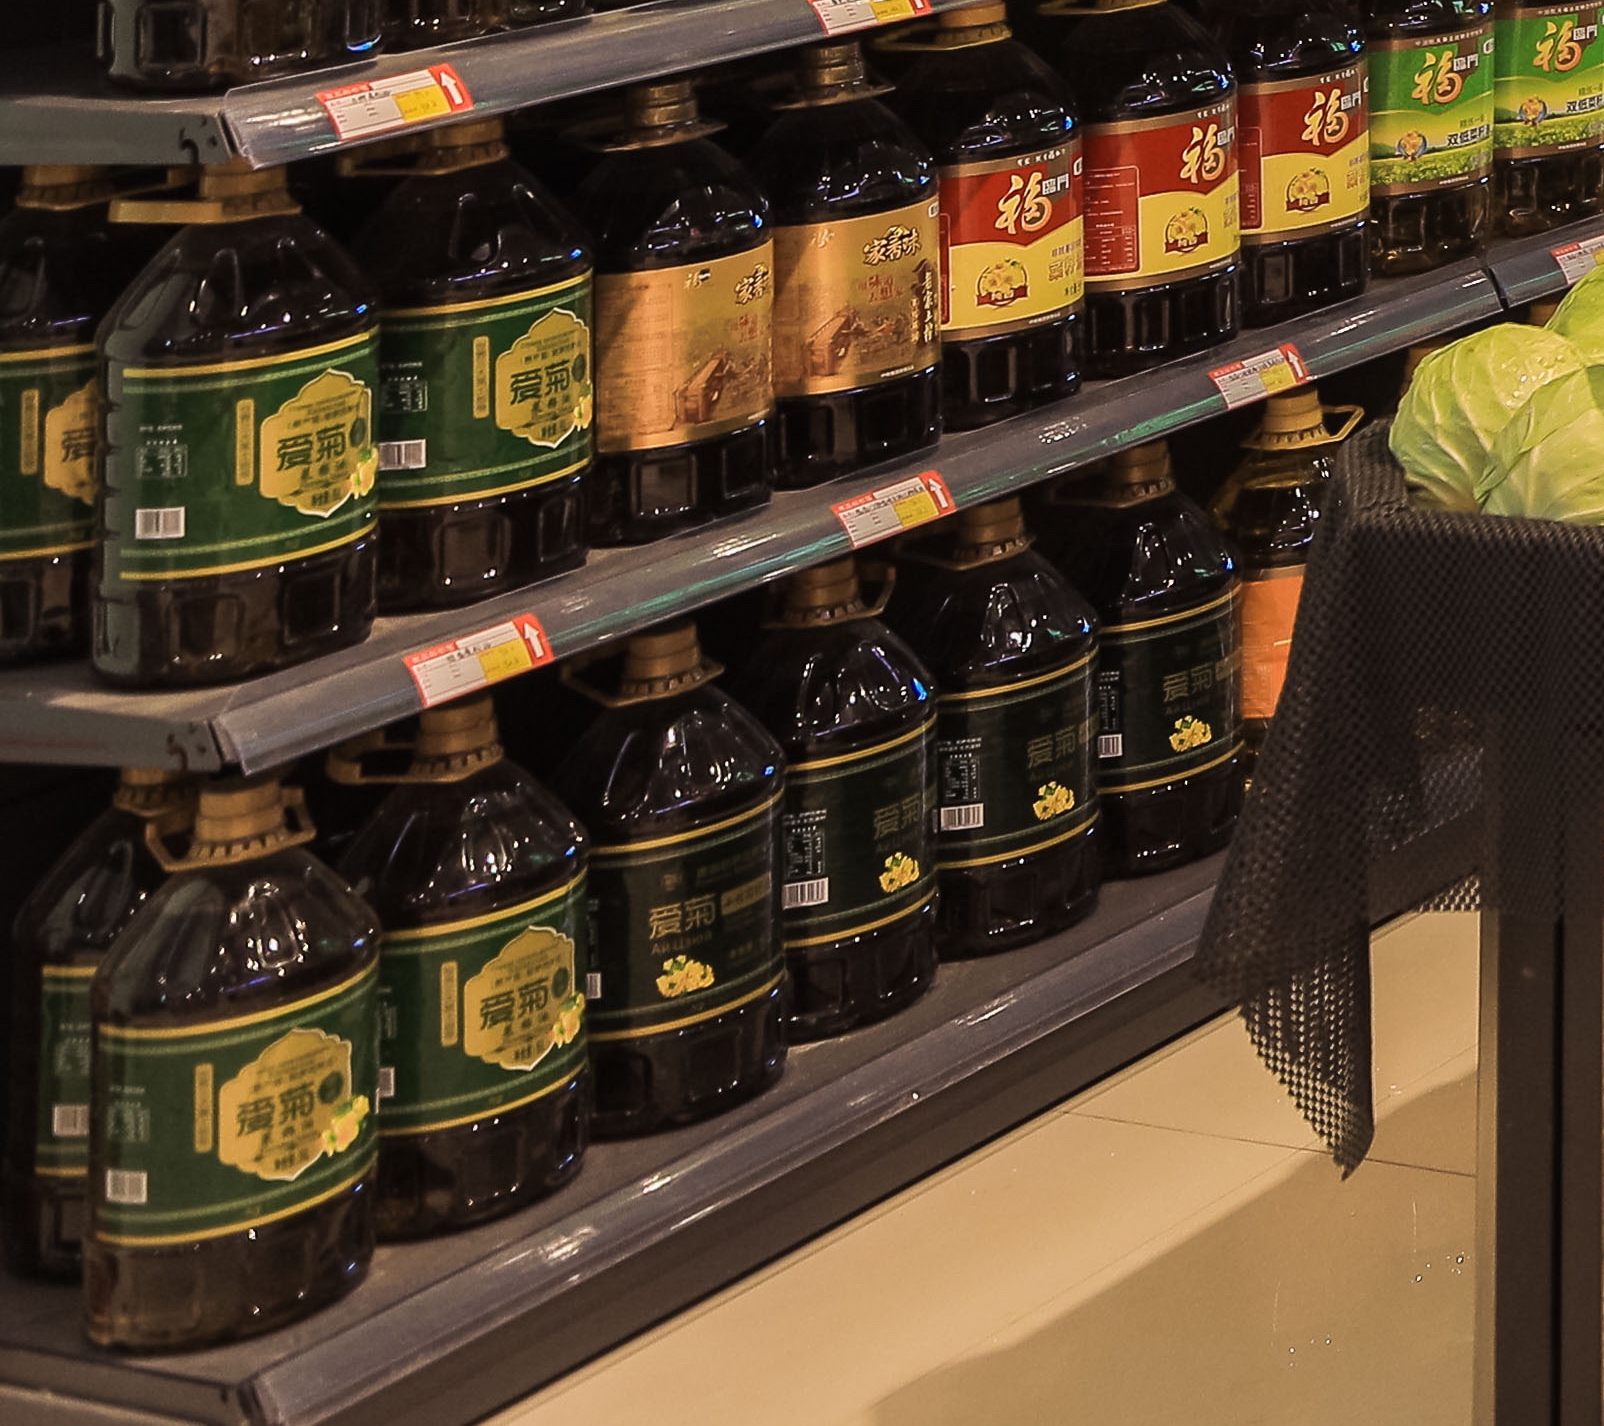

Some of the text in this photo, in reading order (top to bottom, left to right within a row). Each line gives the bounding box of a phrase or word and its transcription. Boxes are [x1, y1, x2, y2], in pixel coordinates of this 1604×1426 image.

[509, 357, 570, 405] 爱菊
[275, 407, 346, 468] 爱菊
[479, 976, 549, 1033] 爱菊
[236, 1082, 316, 1139] 爱菊
